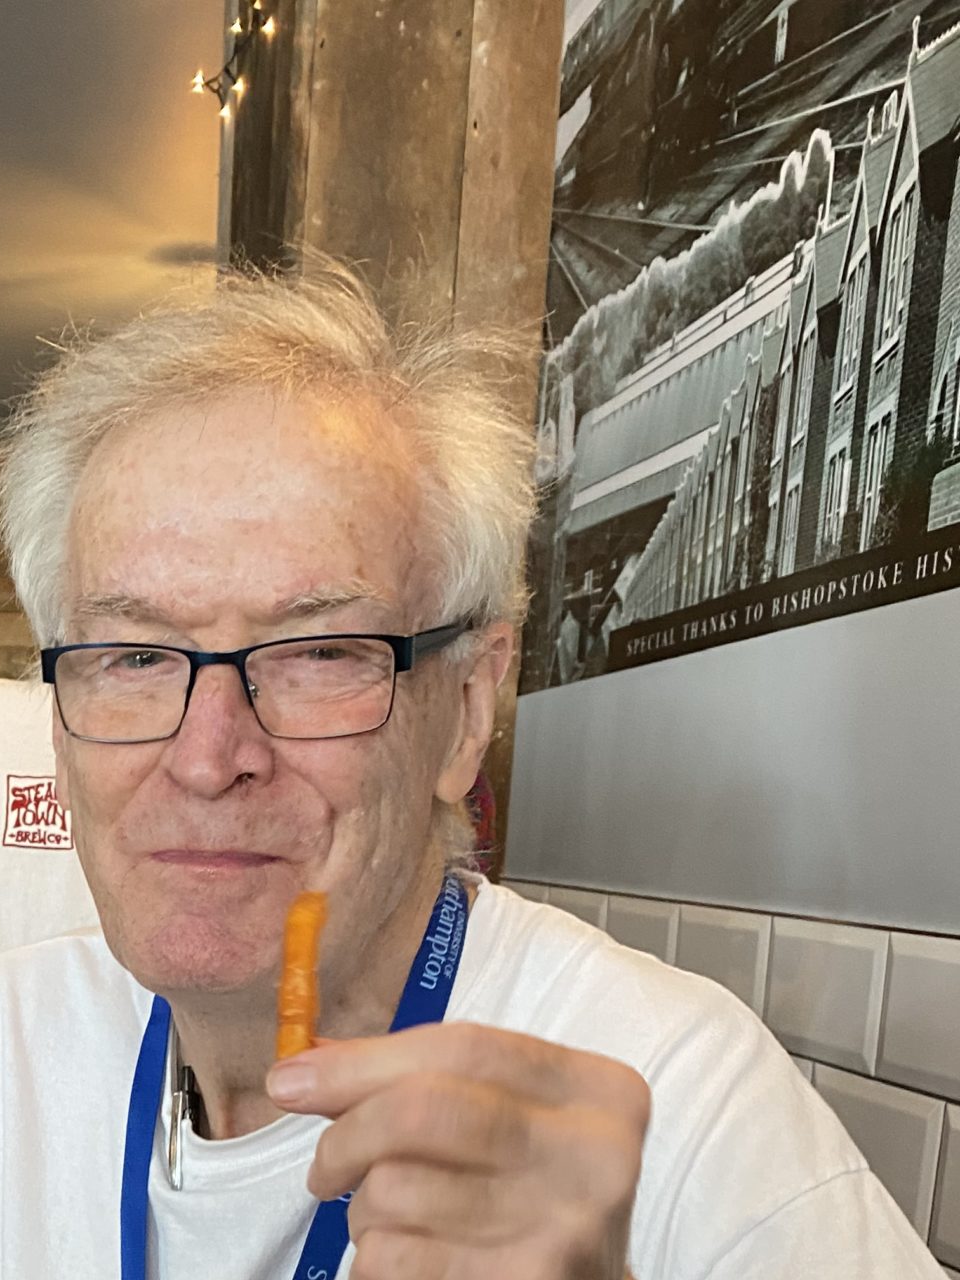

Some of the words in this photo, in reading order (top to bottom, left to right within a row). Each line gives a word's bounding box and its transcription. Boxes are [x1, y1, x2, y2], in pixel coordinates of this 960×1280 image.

[626, 627, 674, 657] SPECIAL
[682, 610, 737, 641] THANKS
[745, 602, 764, 625] TO
[771, 561, 904, 619] BISHOPSTOKE
[916, 546, 960, 580] HIS
[11, 801, 67, 831] TOWN
